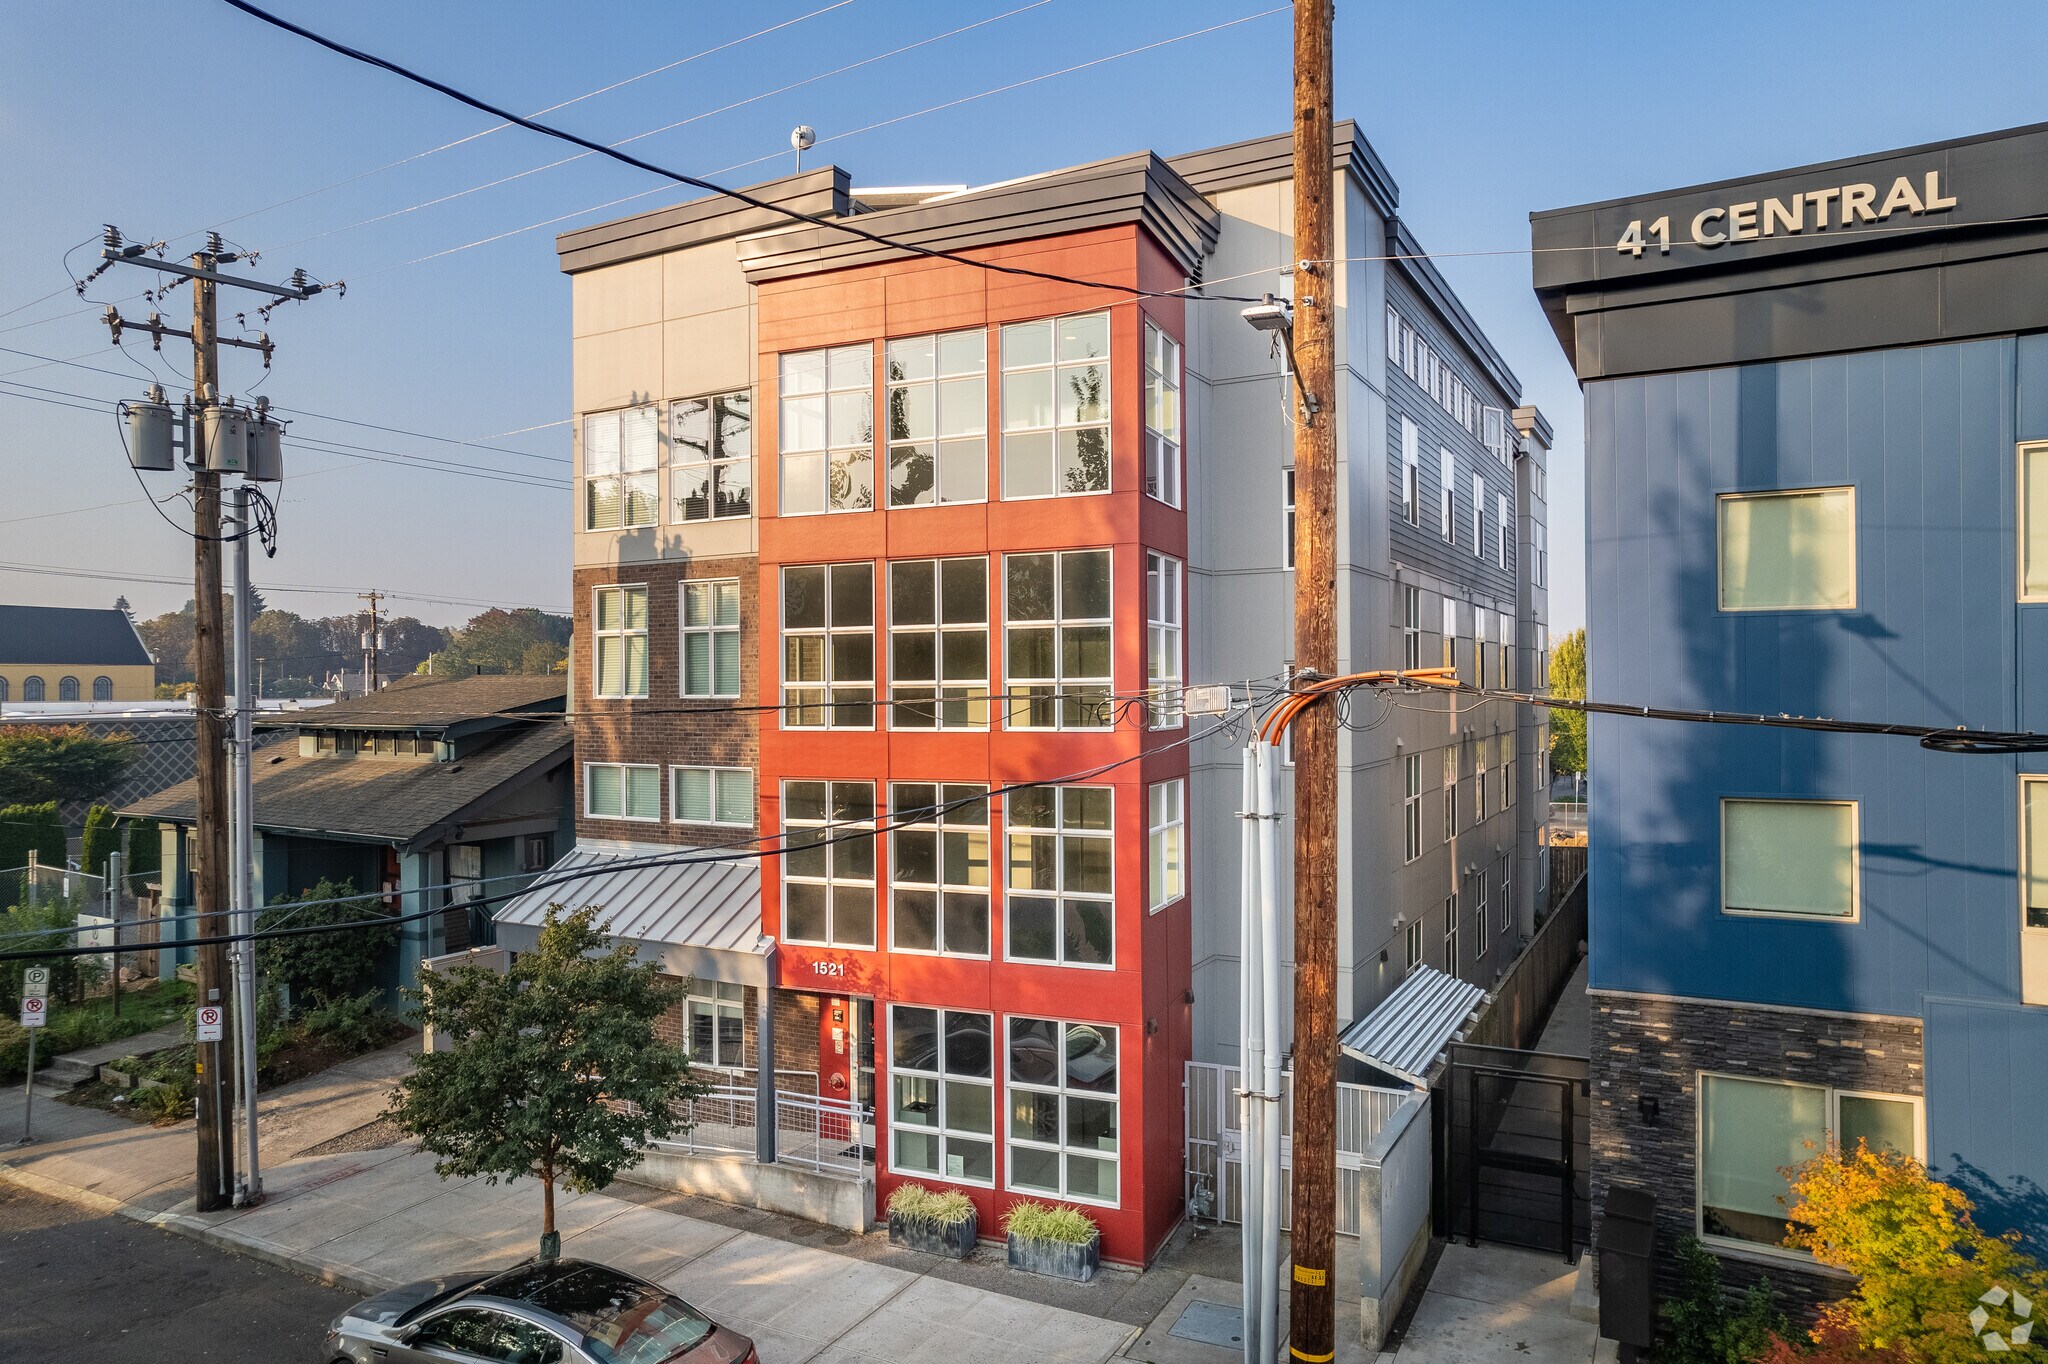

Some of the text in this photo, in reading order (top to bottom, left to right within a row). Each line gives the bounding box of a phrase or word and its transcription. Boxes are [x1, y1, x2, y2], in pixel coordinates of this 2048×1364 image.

[1617, 170, 1957, 256] 41 CENTRAL
[812, 961, 844, 976] 1521
